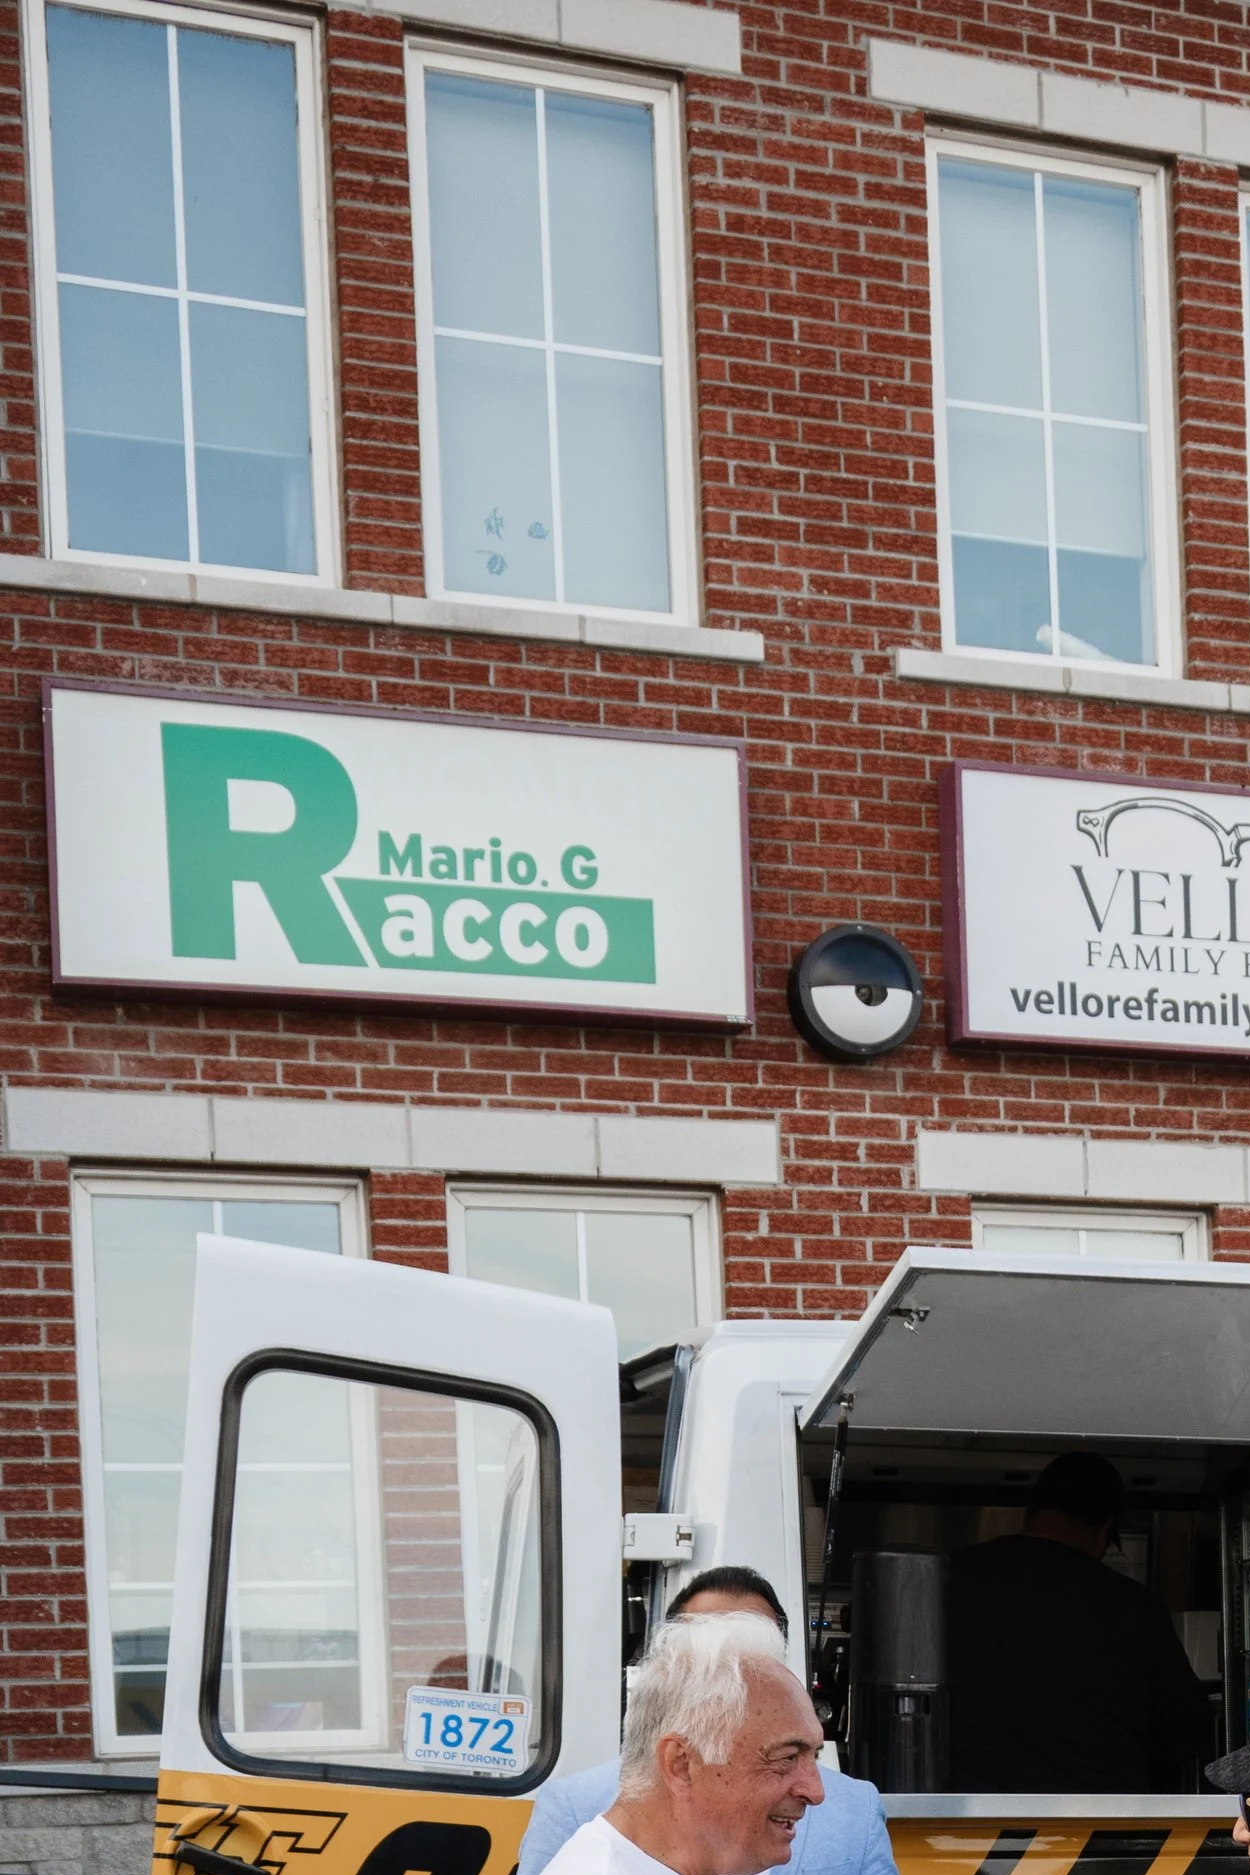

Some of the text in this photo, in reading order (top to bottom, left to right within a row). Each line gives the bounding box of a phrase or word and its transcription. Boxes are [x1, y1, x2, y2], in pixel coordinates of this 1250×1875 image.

[561, 845, 600, 891] G
[1085, 940, 1227, 977] FAMILY
[412, 1694, 465, 1709] REFRESHMENT
[467, 1699, 498, 1713] VEHICLE
[419, 1712, 515, 1755] 1872
[415, 1749, 517, 1768] CITY OF TORONTO
